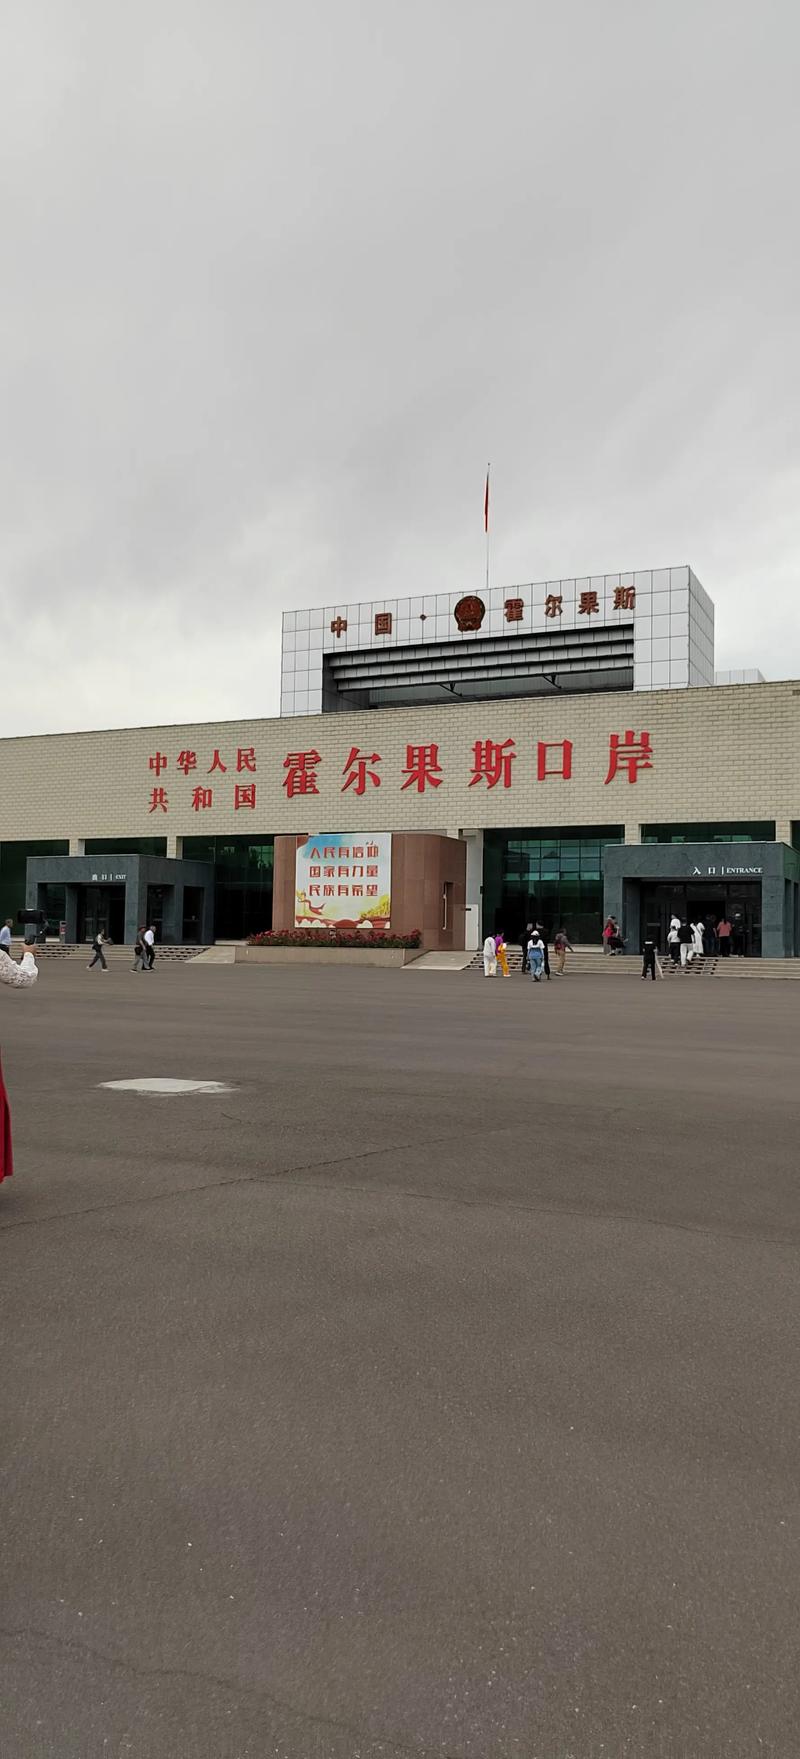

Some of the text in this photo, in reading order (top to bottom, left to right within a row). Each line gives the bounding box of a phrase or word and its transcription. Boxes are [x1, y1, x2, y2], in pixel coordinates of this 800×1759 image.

[503, 585, 636, 623] 霍尔果斯
[148, 747, 257, 777] 中华人民
[281, 729, 655, 799] 霍尔果斯口岸
[148, 783, 257, 814] 共和国
[309, 865, 378, 877] 国家有力量
[692, 866, 716, 875] 入口
[309, 884, 378, 896] 民族有希望
